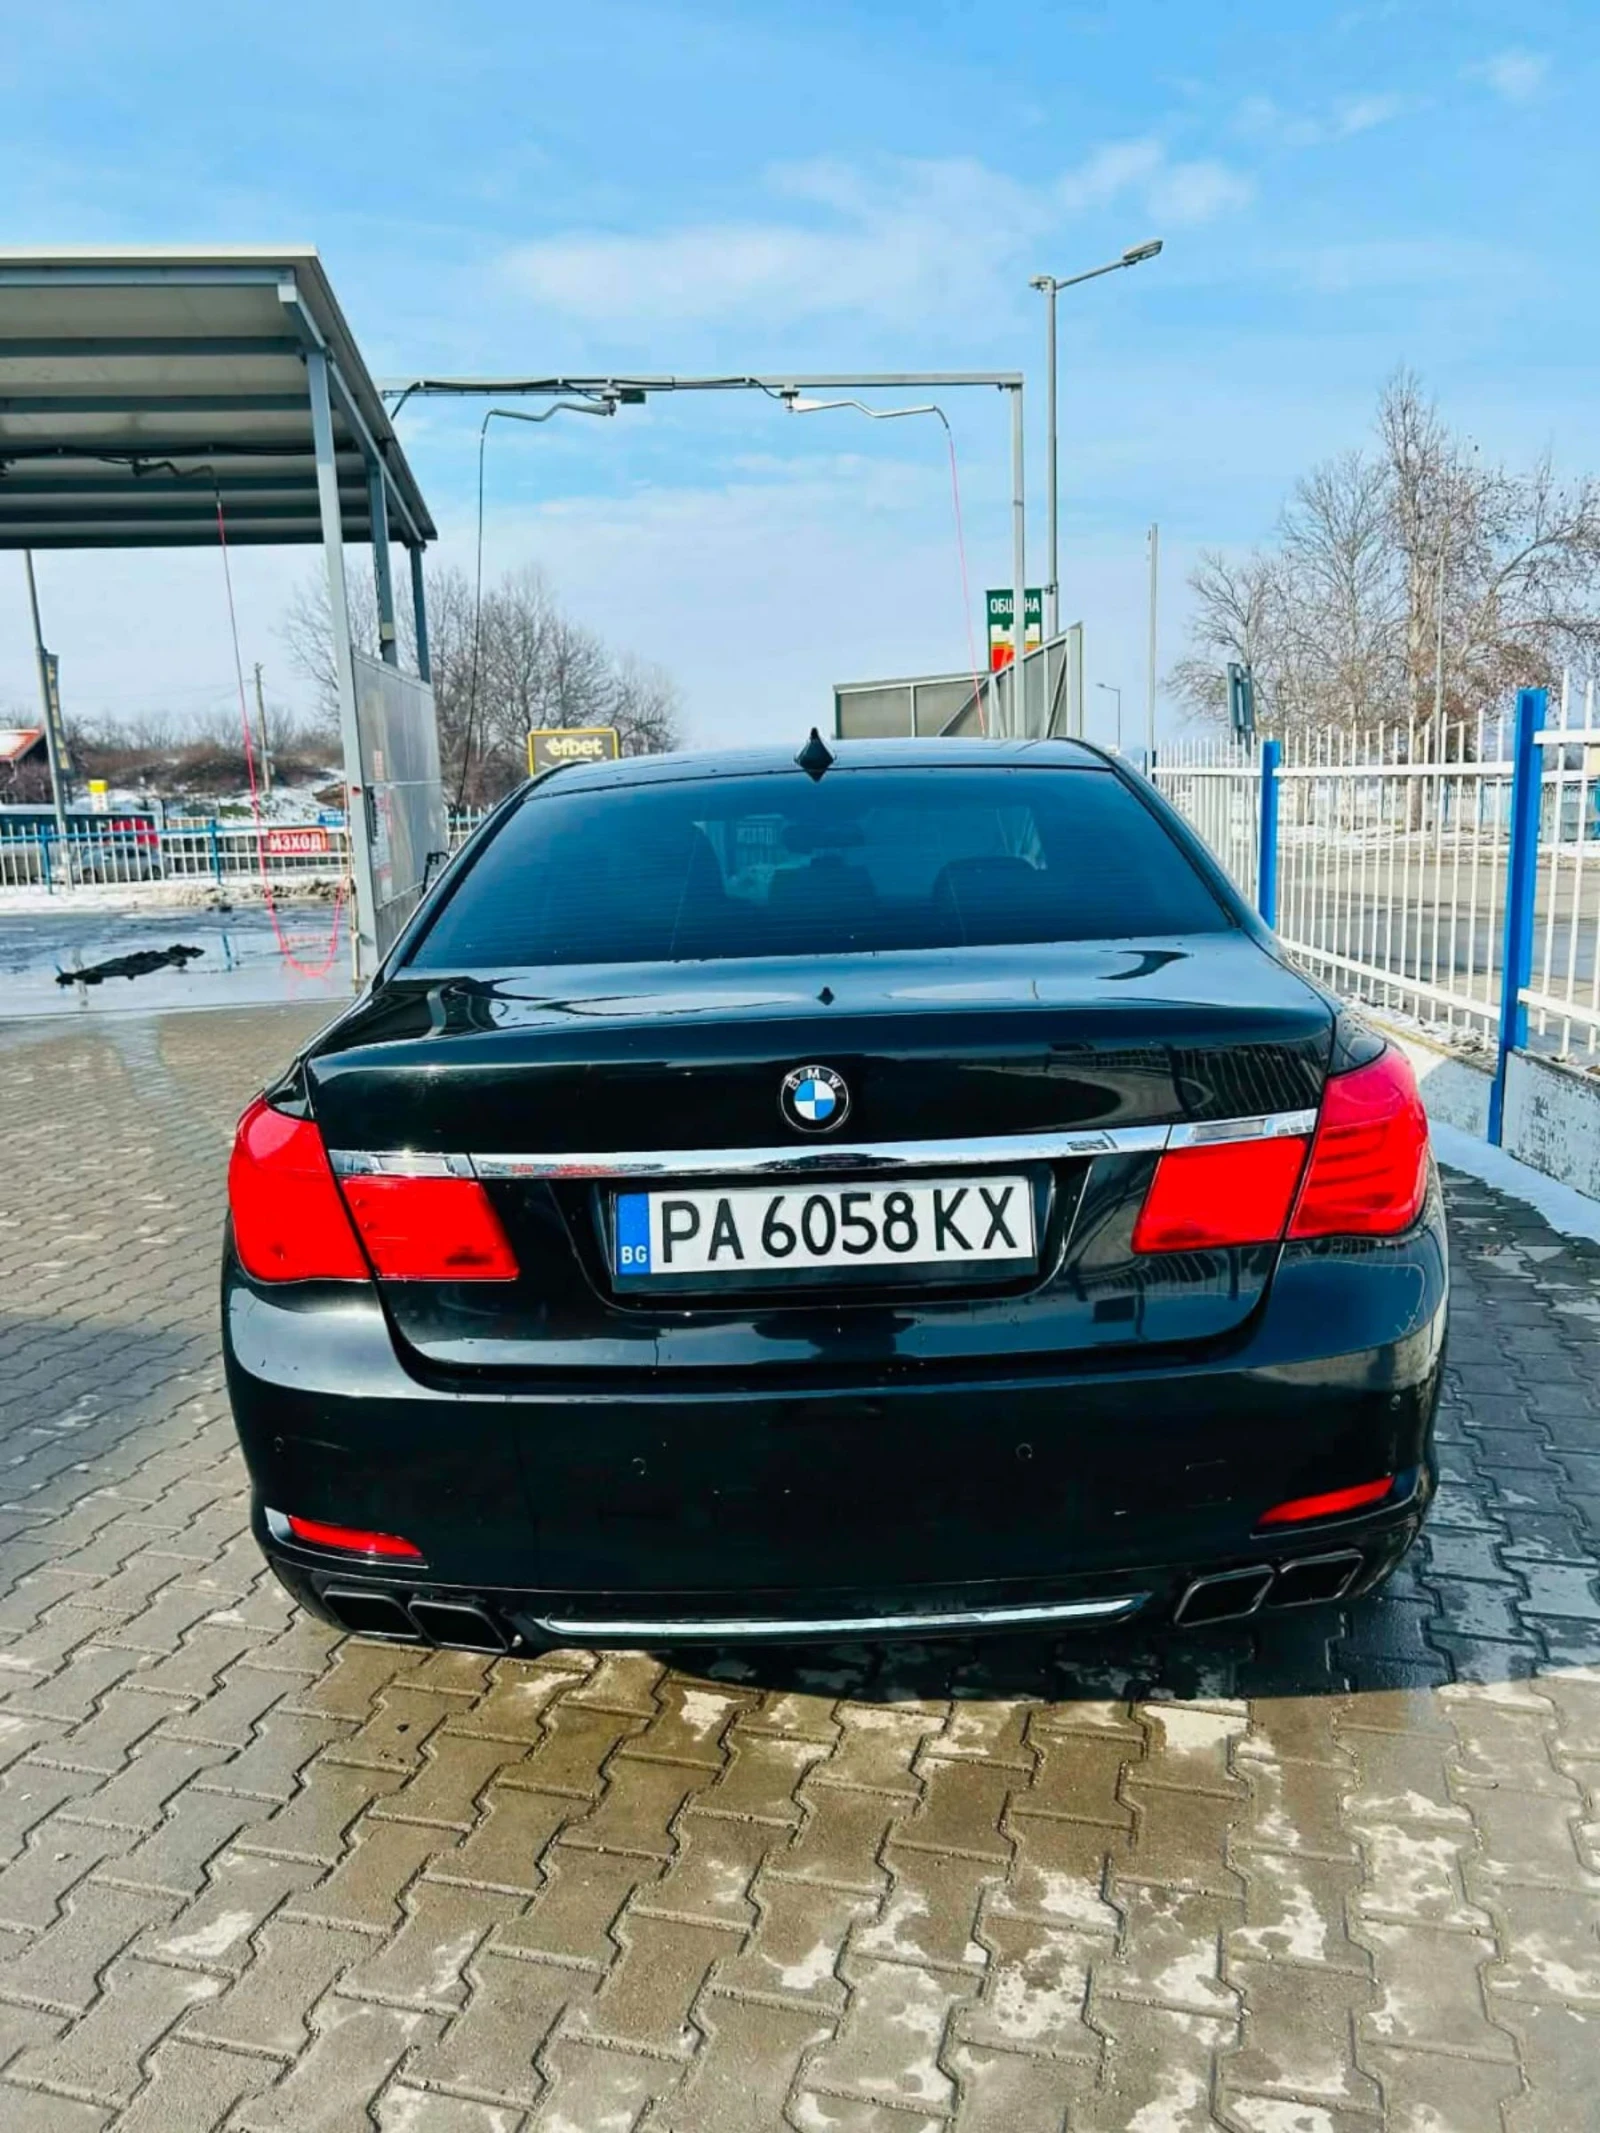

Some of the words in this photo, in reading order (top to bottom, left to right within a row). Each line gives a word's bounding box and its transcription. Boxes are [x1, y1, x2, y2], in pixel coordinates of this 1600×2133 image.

[990, 598, 1040, 614] ОБЩНА
[547, 738, 603, 756] efbet
[269, 833, 321, 852] ИЗХОД
[786, 1068, 841, 1091] BMW
[761, 1192, 919, 1258] 6058
[621, 1245, 647, 1264] BG
